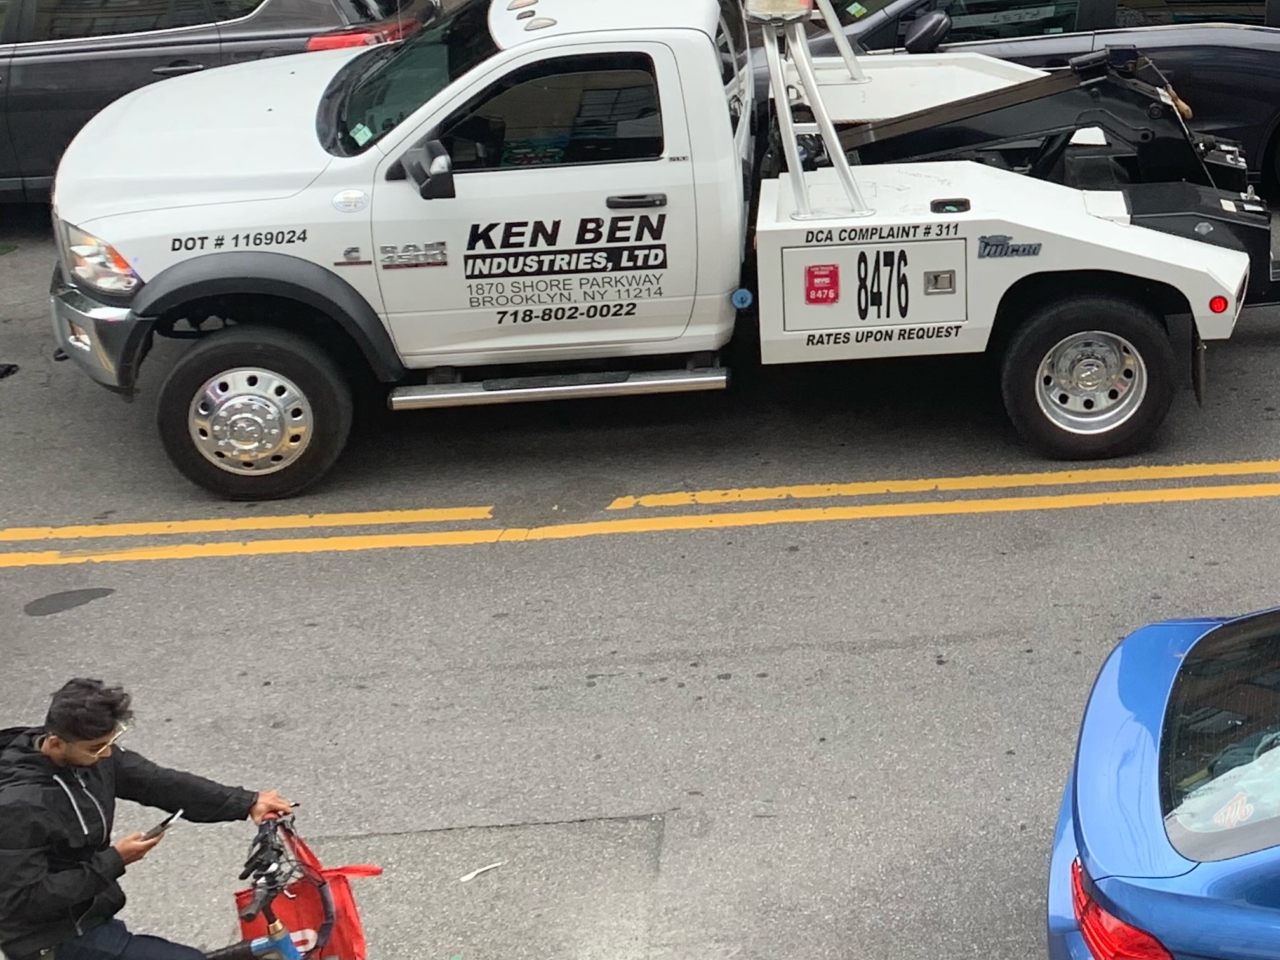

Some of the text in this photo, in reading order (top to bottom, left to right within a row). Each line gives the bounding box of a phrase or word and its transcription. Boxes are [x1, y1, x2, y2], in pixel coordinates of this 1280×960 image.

[171, 229, 308, 251] DOT # 1169024
[466, 214, 667, 251] KEN BEN
[805, 223, 960, 244] DCA COMPLAINT # 311
[465, 248, 665, 276] INDUSTRIES, LTD
[467, 273, 664, 296] 1870 SHORE PARKWAY
[810, 289, 835, 299] 8476
[857, 249, 910, 321] 8476
[469, 286, 664, 308] BROOKLYN, NY 11214
[496, 302, 638, 325] 718-802-0022
[806, 325, 962, 346] RATES UPON REQUEST
